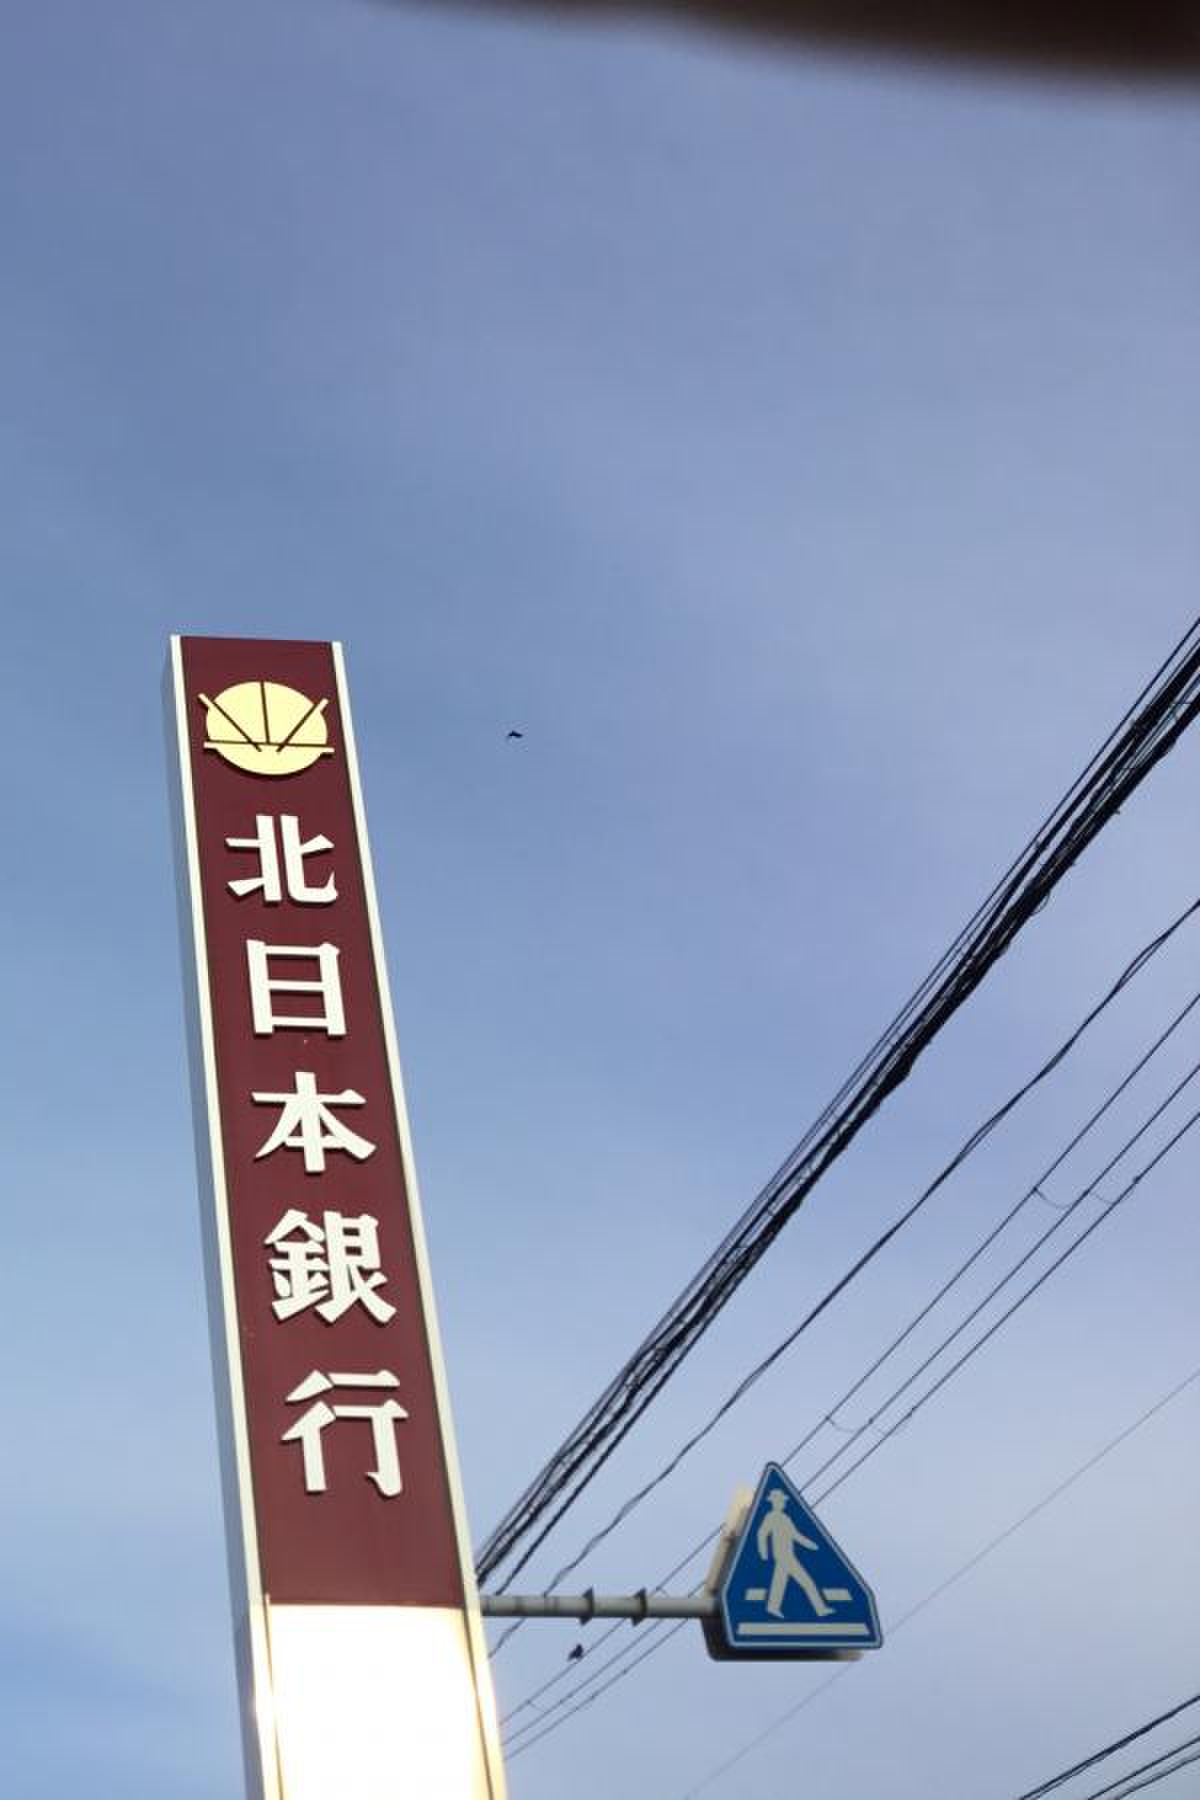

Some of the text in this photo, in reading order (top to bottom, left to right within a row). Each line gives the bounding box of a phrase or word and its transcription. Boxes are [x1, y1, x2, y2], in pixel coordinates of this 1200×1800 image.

[225, 814, 409, 1497] 北日本銀行
